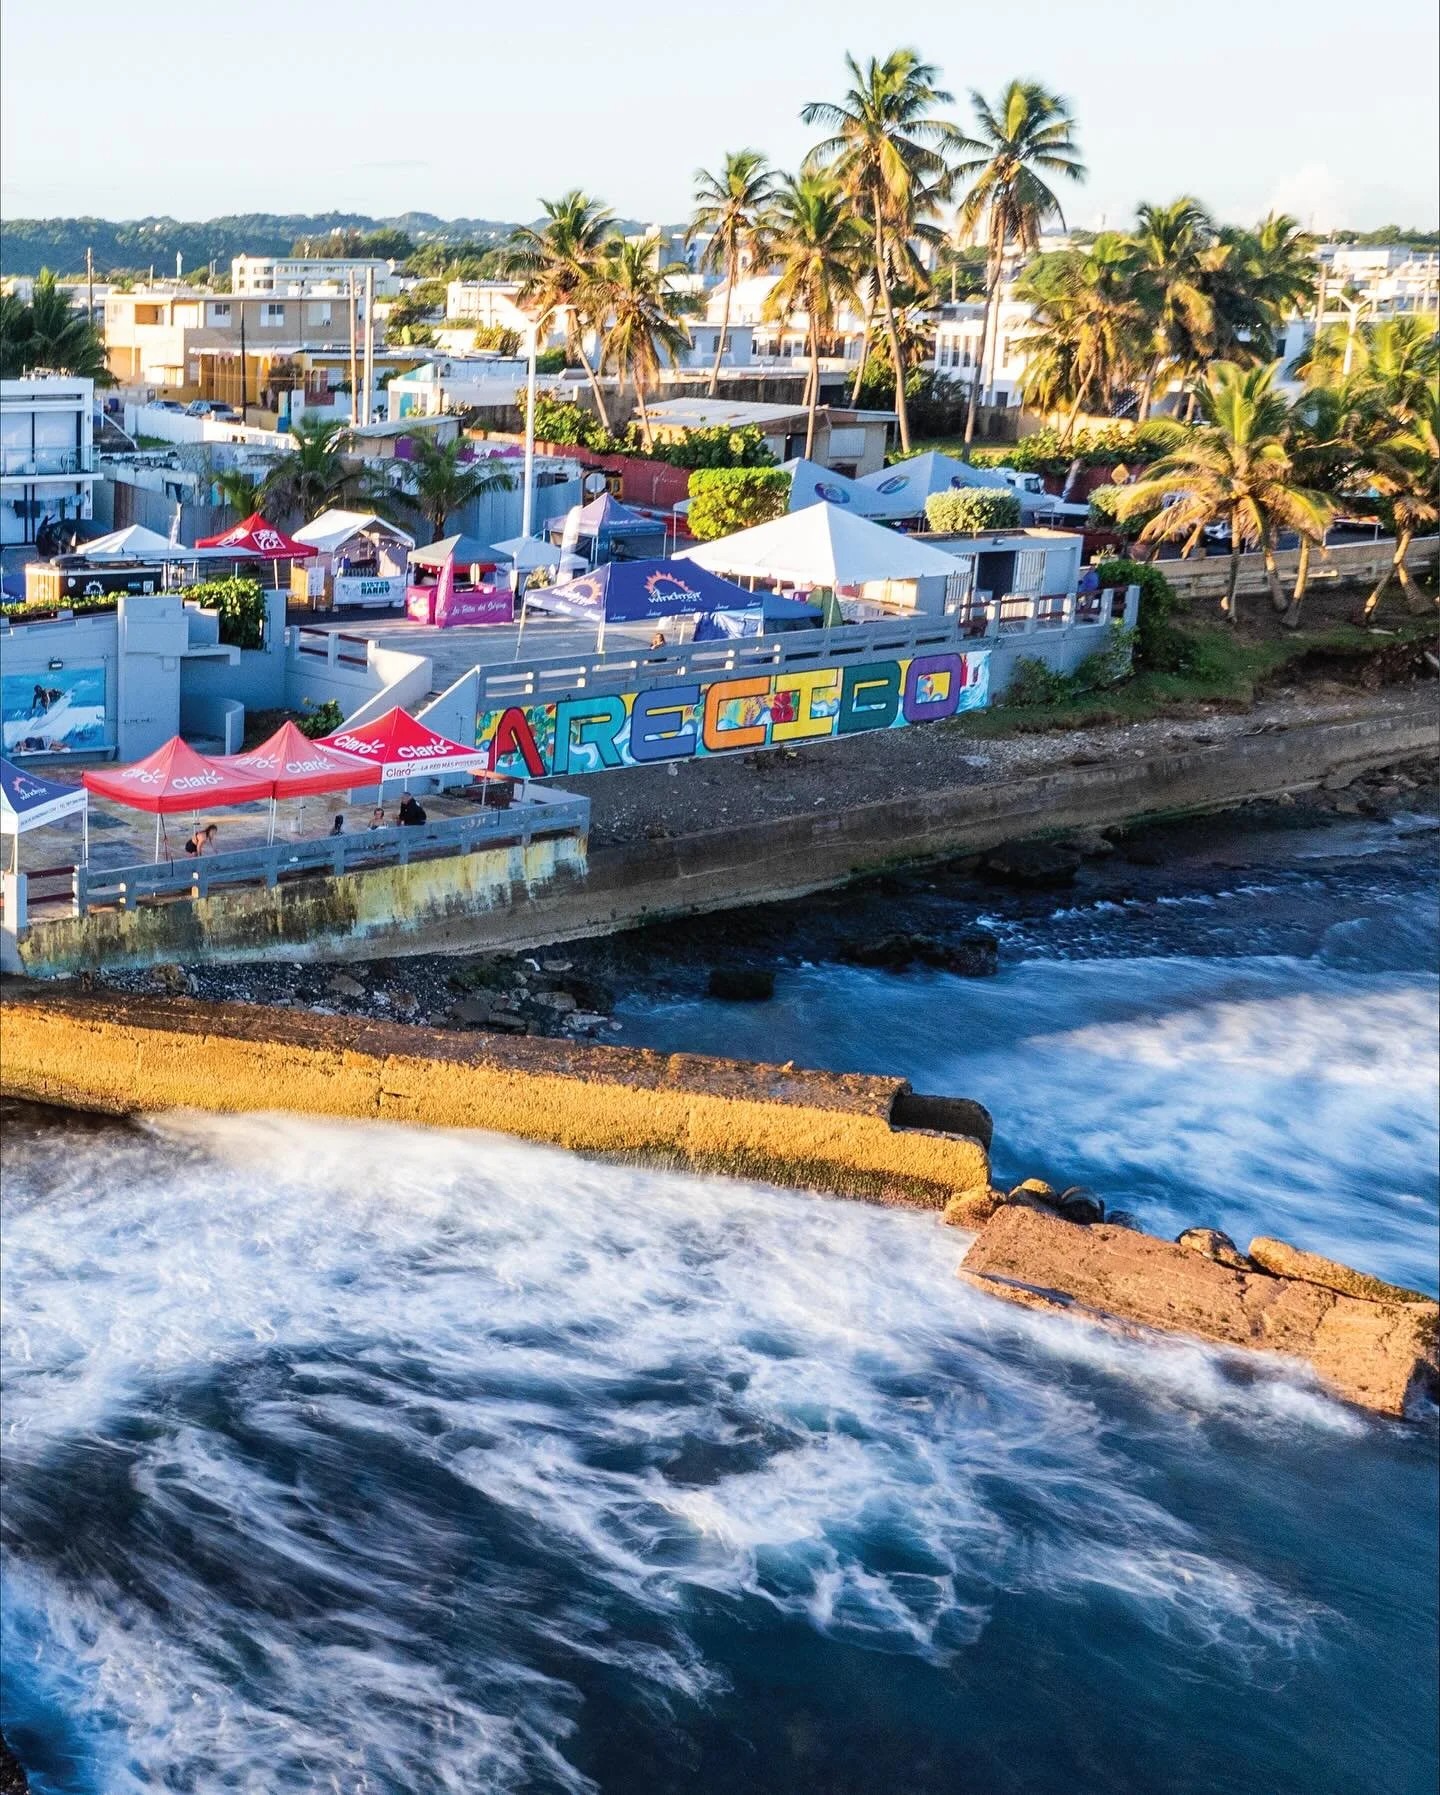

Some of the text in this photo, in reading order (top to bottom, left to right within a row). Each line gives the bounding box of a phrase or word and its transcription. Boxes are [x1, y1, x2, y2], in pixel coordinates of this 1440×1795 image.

[475, 652, 963, 783] ARECIBO
[333, 735, 379, 754] Claro
[397, 741, 450, 758] Claro
[286, 757, 331, 774] Claro
[386, 766, 412, 778] Claro
[172, 772, 219, 789] Claro
